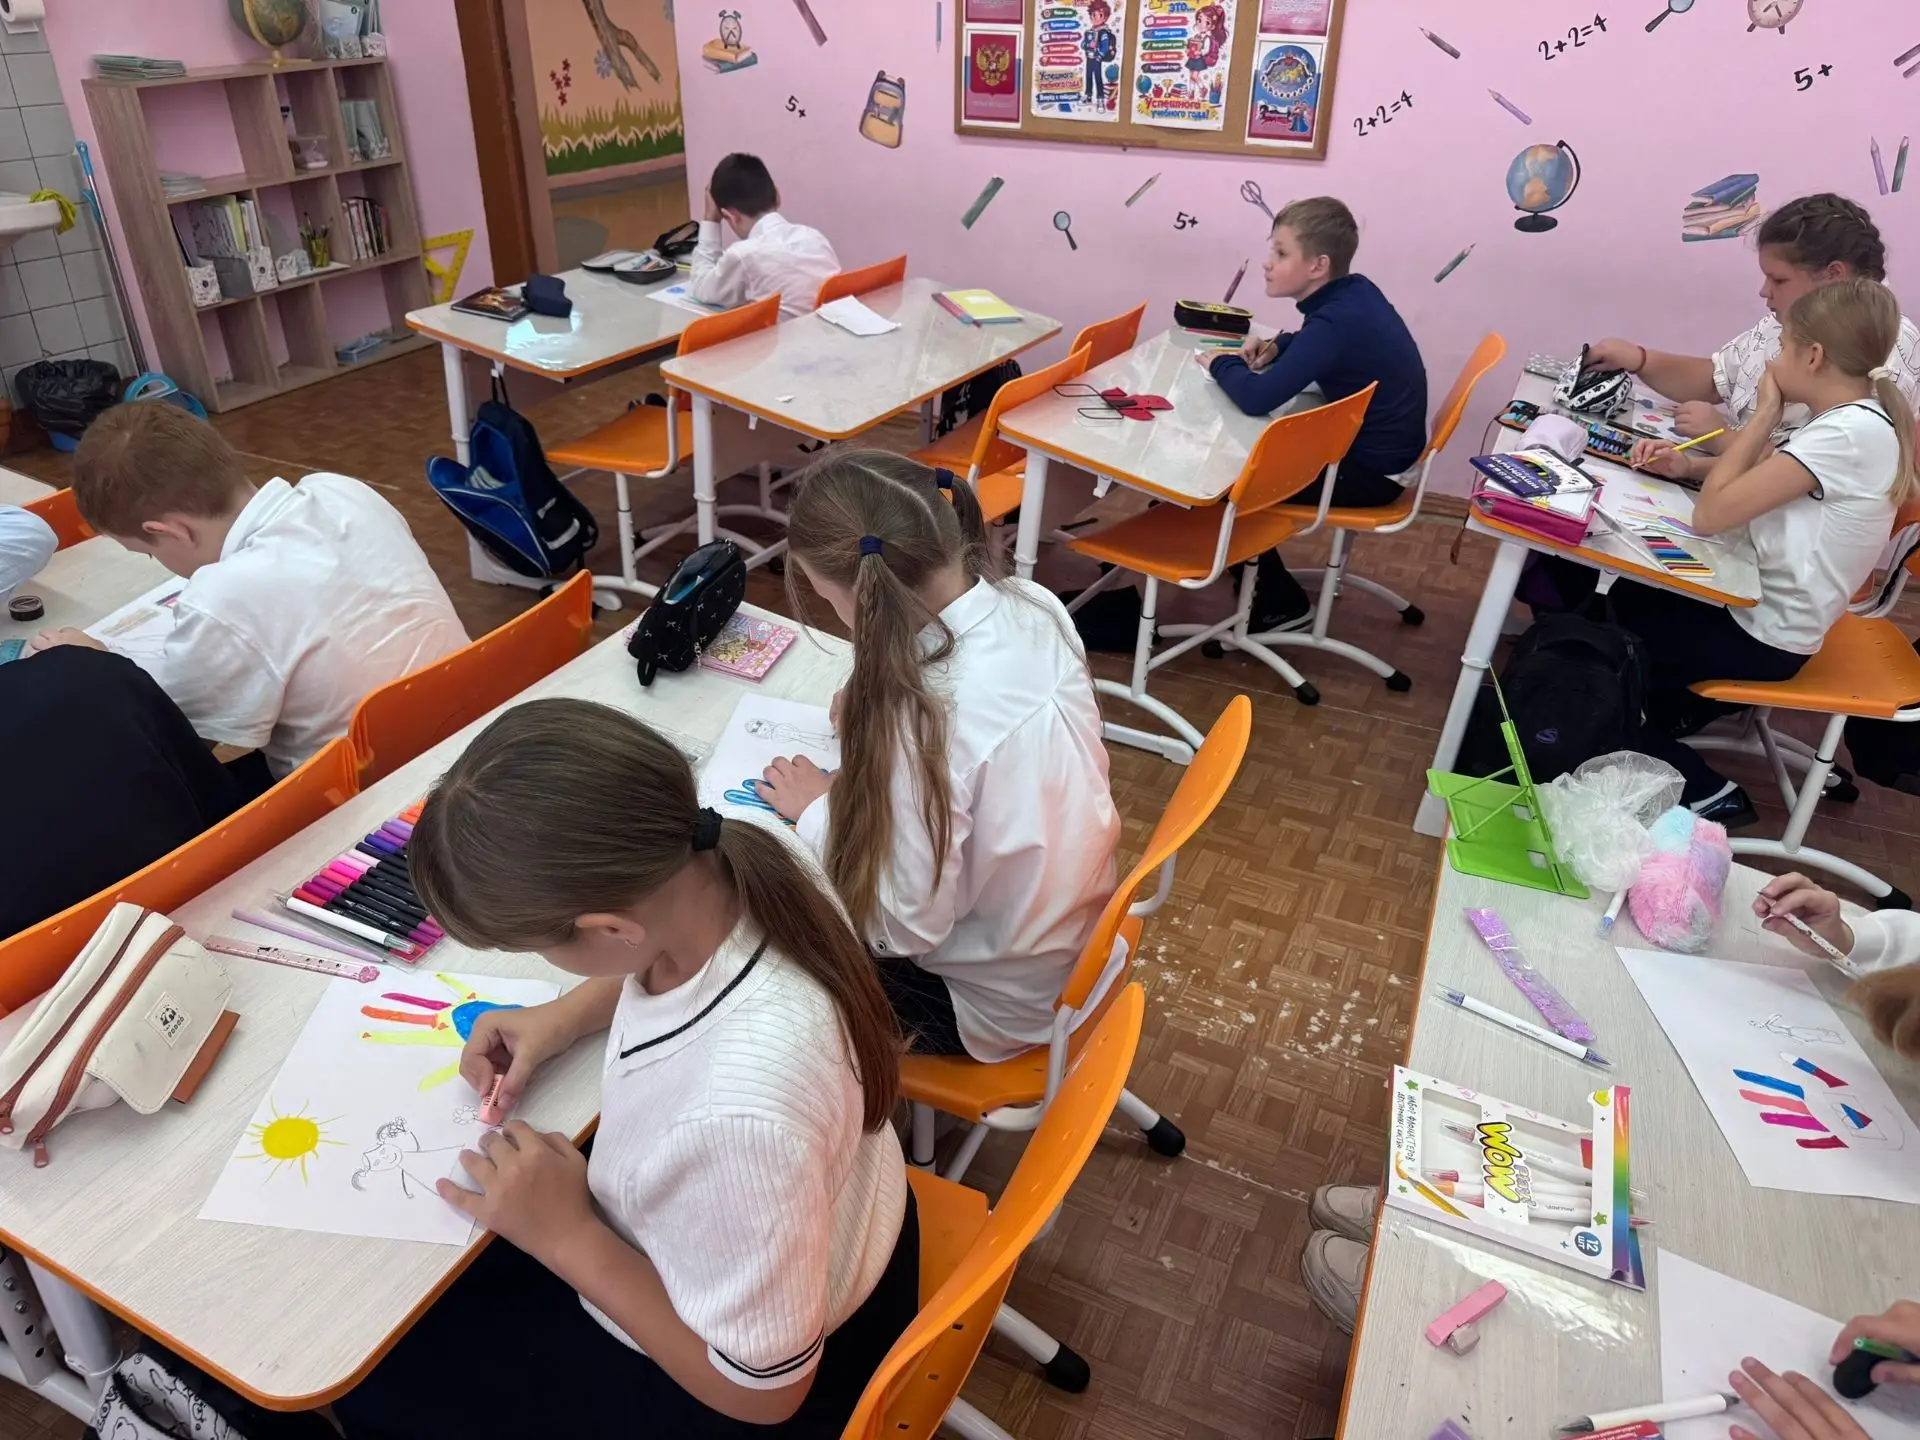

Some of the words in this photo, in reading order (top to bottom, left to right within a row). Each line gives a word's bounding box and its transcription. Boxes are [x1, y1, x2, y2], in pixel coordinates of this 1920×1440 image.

[1538, 12, 1607, 61] 2+2=4
[1040, 72, 1073, 80] Успешного
[1040, 81, 1065, 89] учебного
[1794, 64, 1833, 91] 5+
[785, 95, 806, 119] 5+
[1145, 98, 1200, 110] Успешного
[1353, 90, 1413, 137] 2+2=4
[1152, 109, 1185, 119] учебного
[1188, 110, 1210, 120] года!
[1173, 211, 1199, 230] 5+
[1476, 1121, 1523, 1204] WOW
[1586, 1238, 1600, 1253] 12
